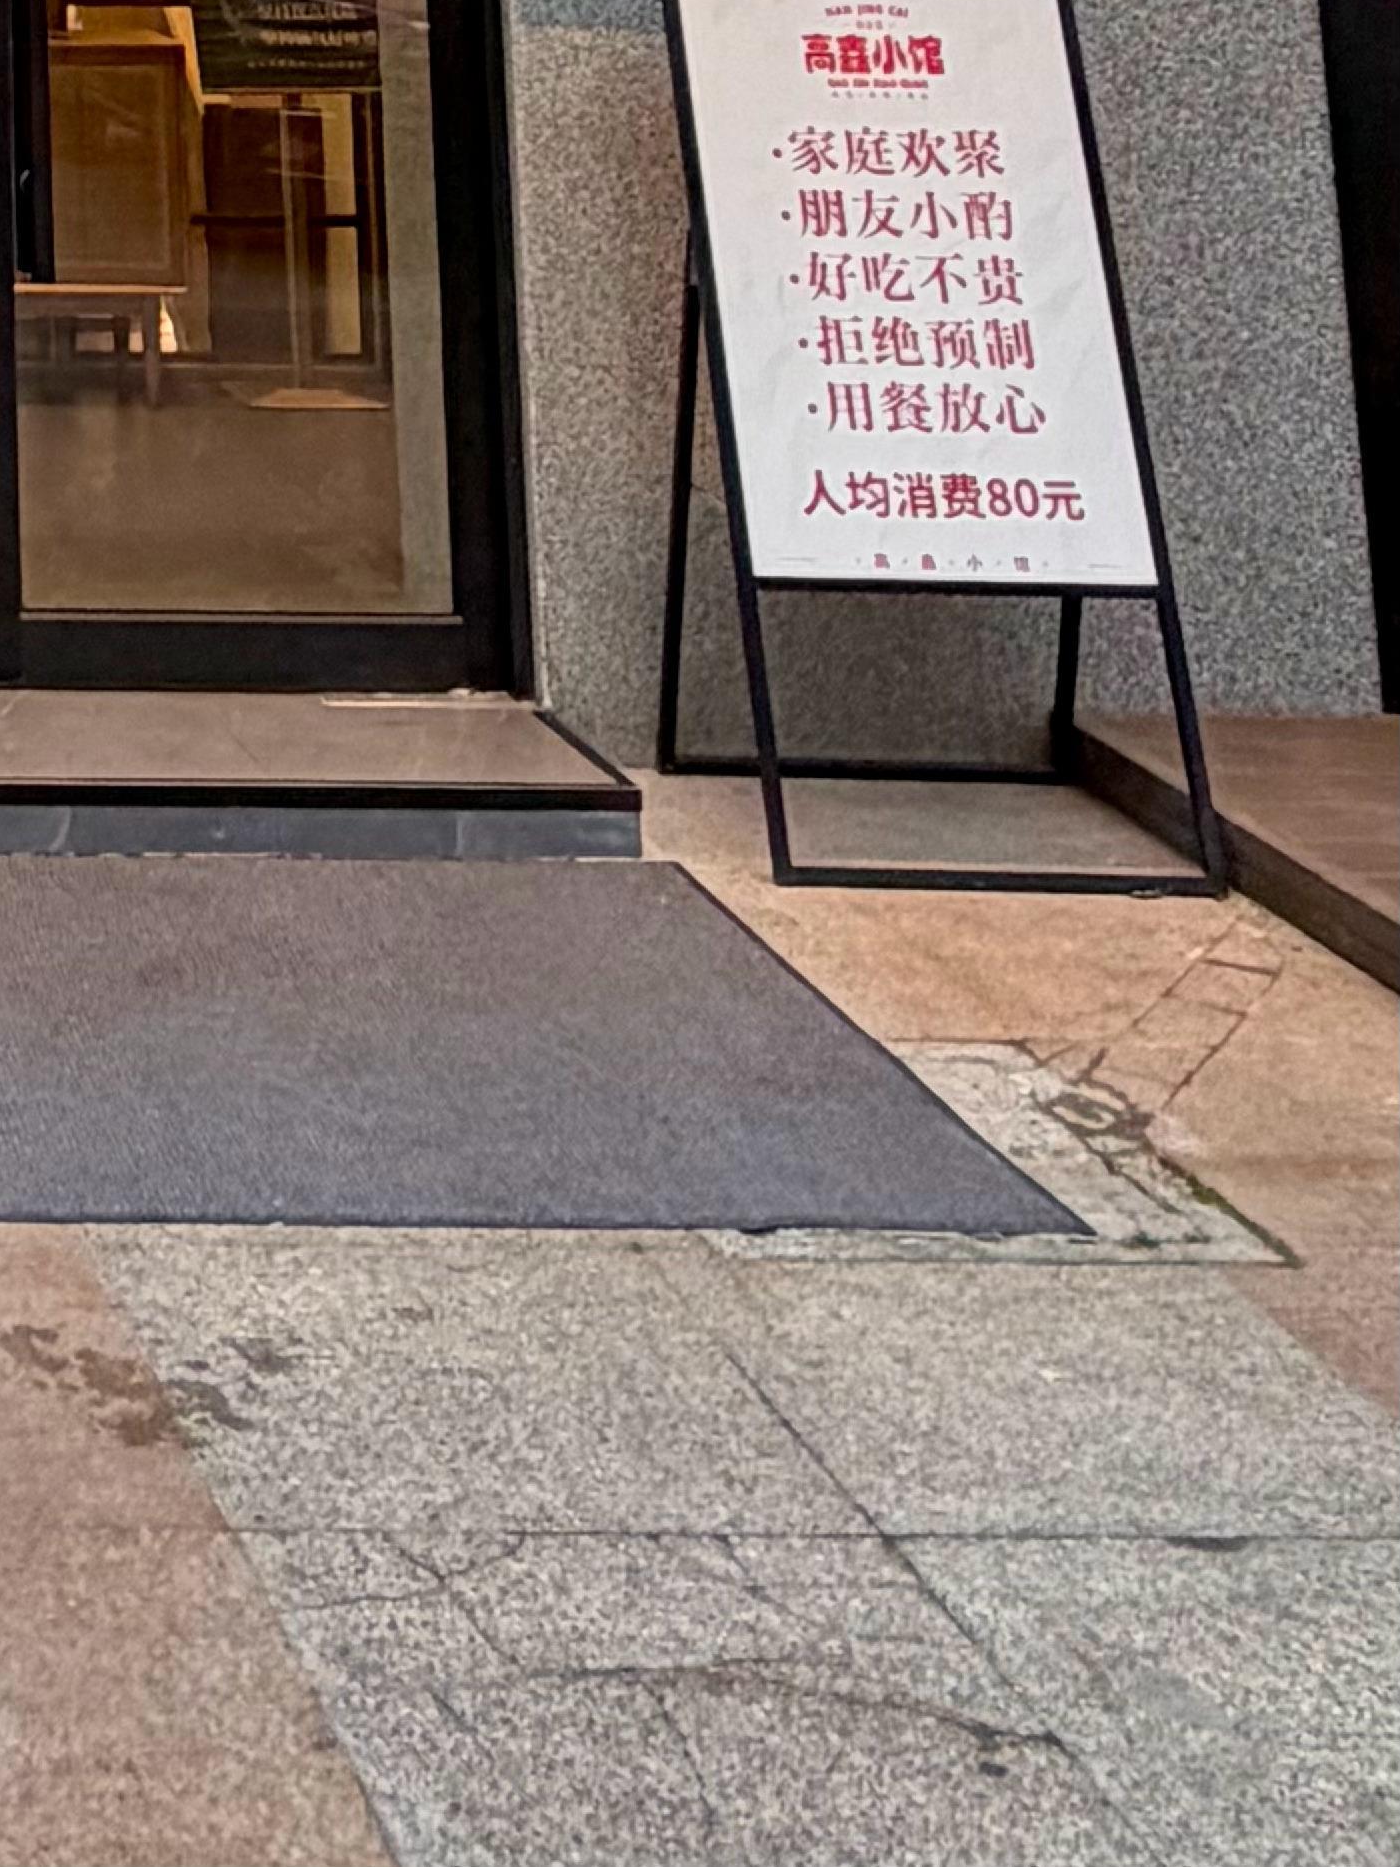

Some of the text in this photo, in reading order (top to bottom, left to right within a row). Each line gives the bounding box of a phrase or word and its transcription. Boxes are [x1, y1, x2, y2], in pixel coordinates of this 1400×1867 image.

[801, 33, 946, 75] 高鑫小馆
[786, 125, 1006, 180] 家庭欢聚
[798, 189, 1015, 242] 朋友小酌
[807, 252, 1025, 307] 好吃不贵
[815, 316, 1036, 372] 拒绝预制
[826, 381, 1047, 435] 用餐放心
[803, 470, 1086, 522] 人均消费80元
